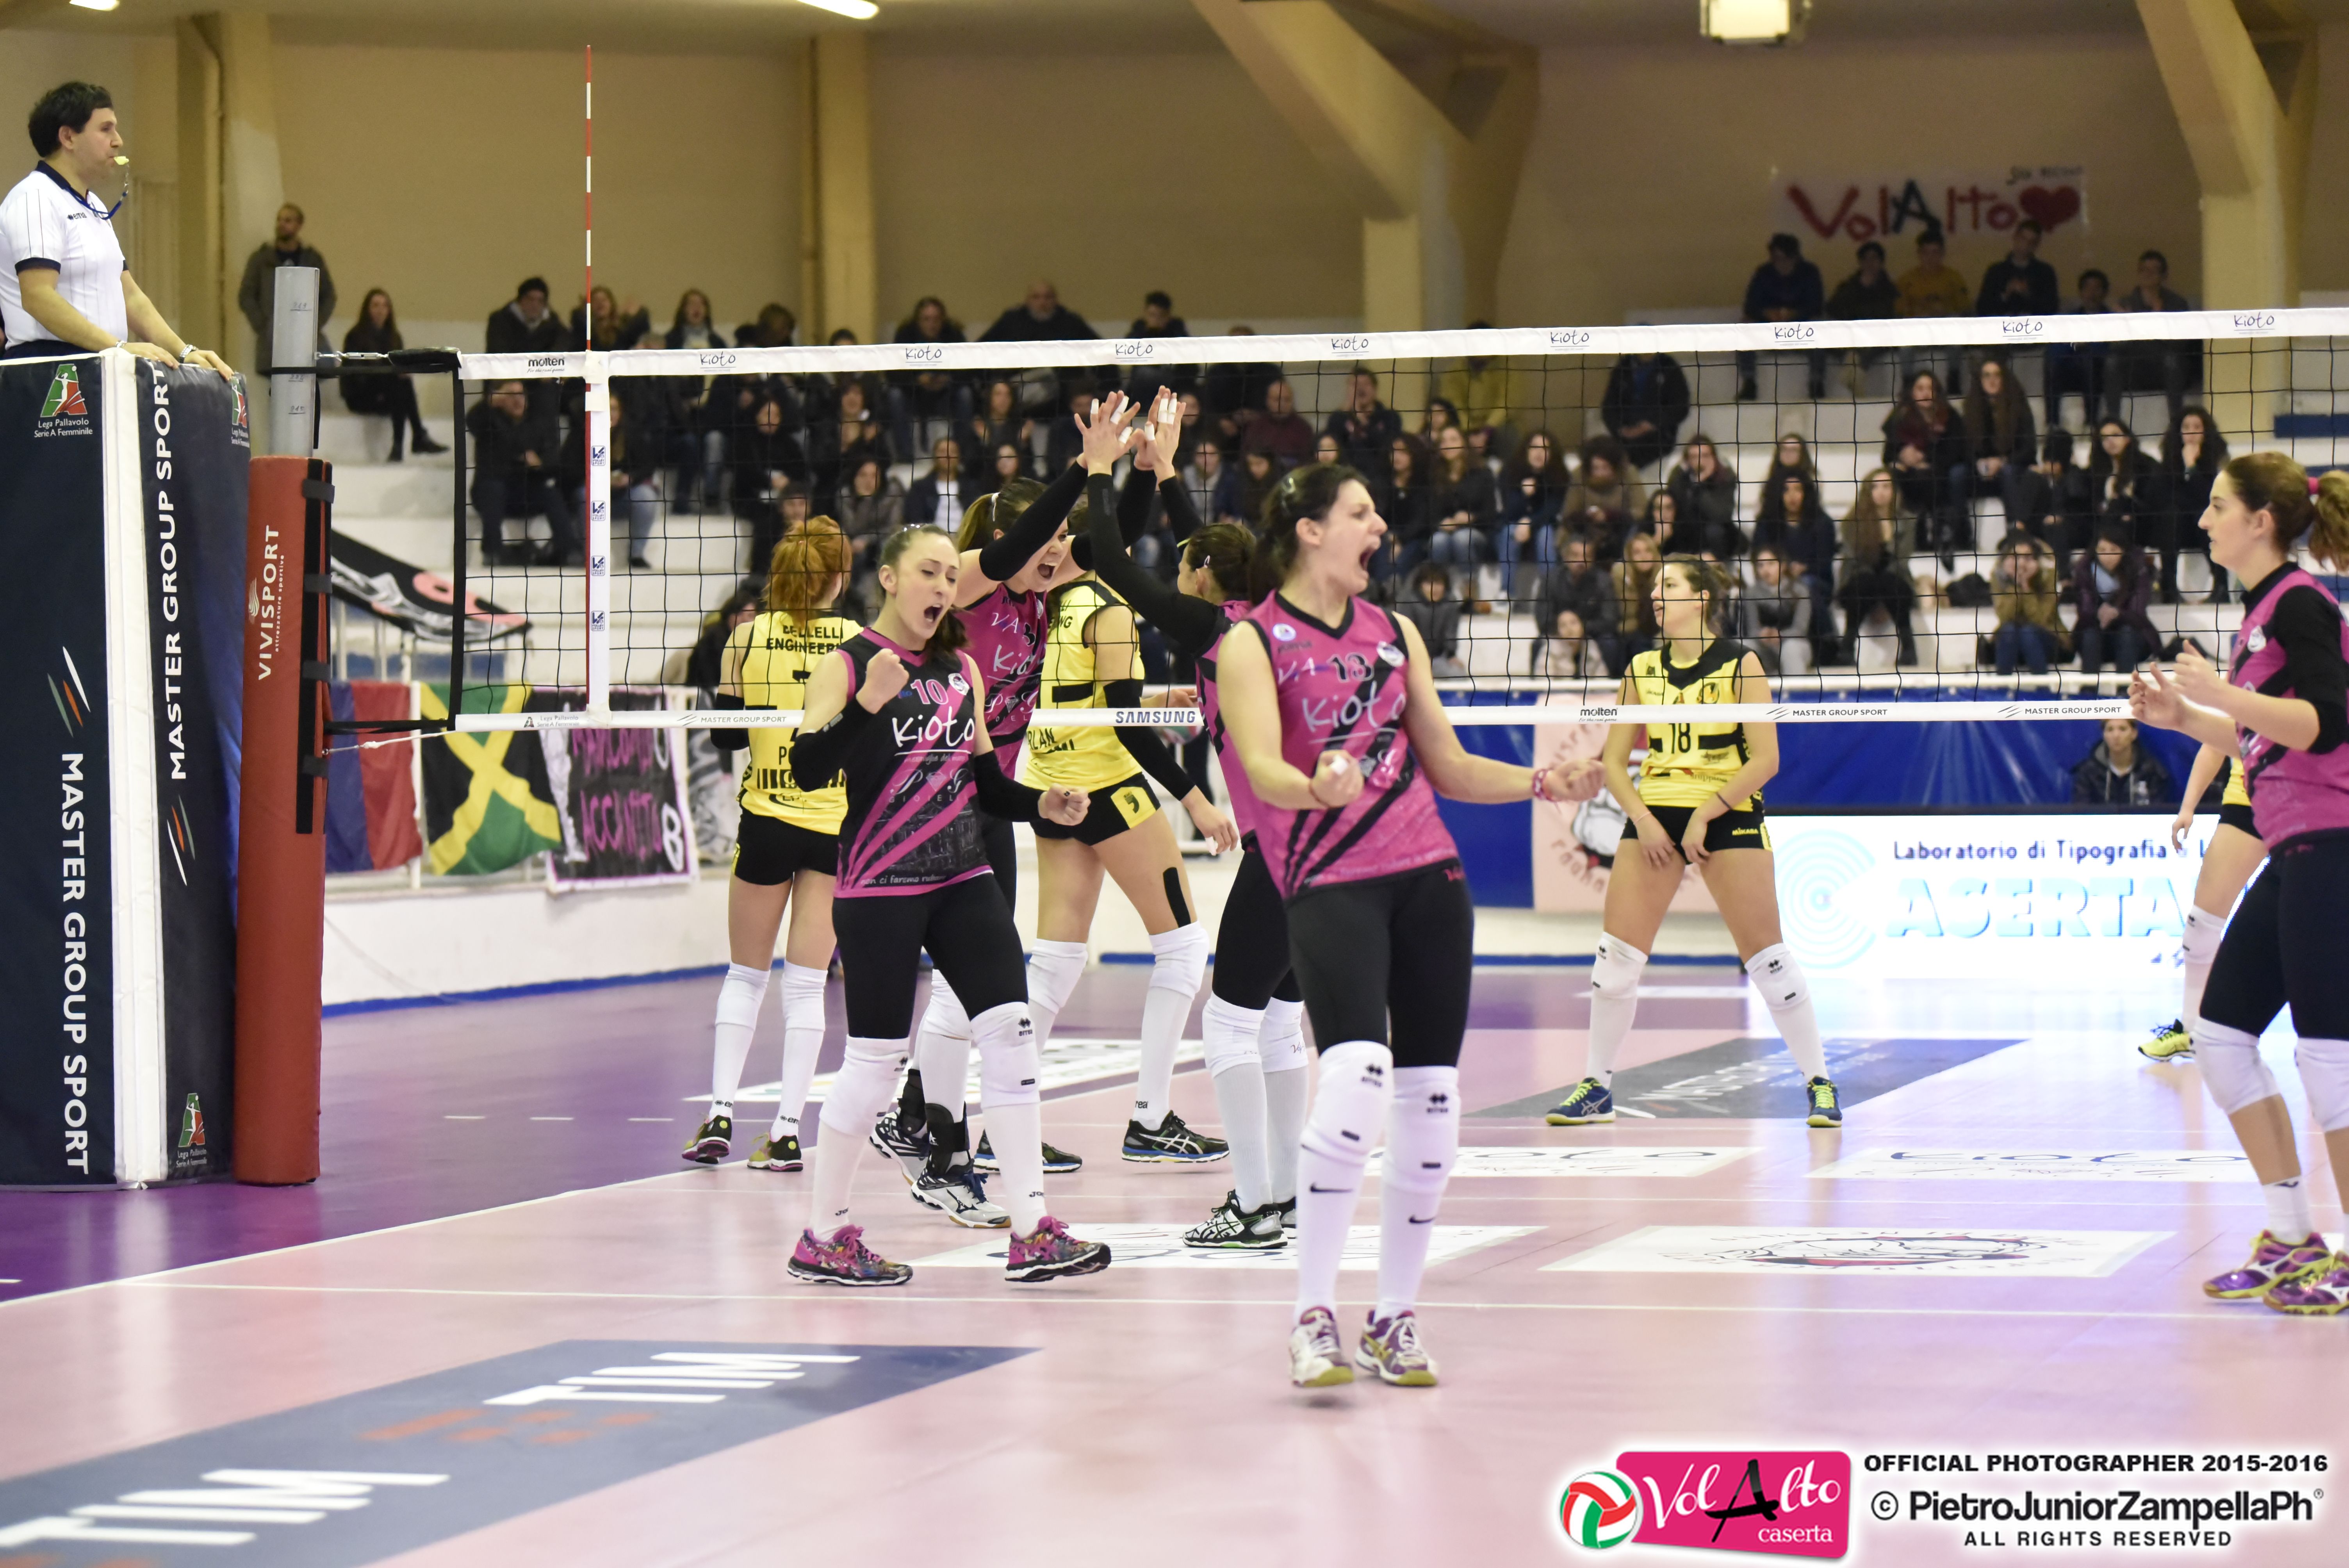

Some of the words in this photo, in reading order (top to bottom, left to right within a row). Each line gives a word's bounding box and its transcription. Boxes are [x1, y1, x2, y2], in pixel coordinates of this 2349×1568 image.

[529, 358, 565, 367] molten
[38, 421, 53, 429] Lega
[55, 418, 89, 426] Pallavolo
[58, 428, 93, 436] Femminile
[149, 362, 172, 479] SPORT
[158, 491, 179, 622] GROUP
[258, 525, 279, 680] VIVISPORT
[1326, 652, 1375, 683] 13
[165, 632, 187, 779] MASTER
[911, 679, 949, 704] 10
[1116, 711, 1196, 723] SAMSUNG
[1580, 707, 1617, 716] molten
[1668, 723, 1691, 754] 18
[62, 754, 86, 902] MASTER
[1895, 841, 2018, 859] Laboratorio
[2028, 841, 2045, 859] di
[2057, 839, 2167, 865] Tipografia
[63, 912, 87, 1044] GROUP
[63, 1055, 89, 1174] SPORT
